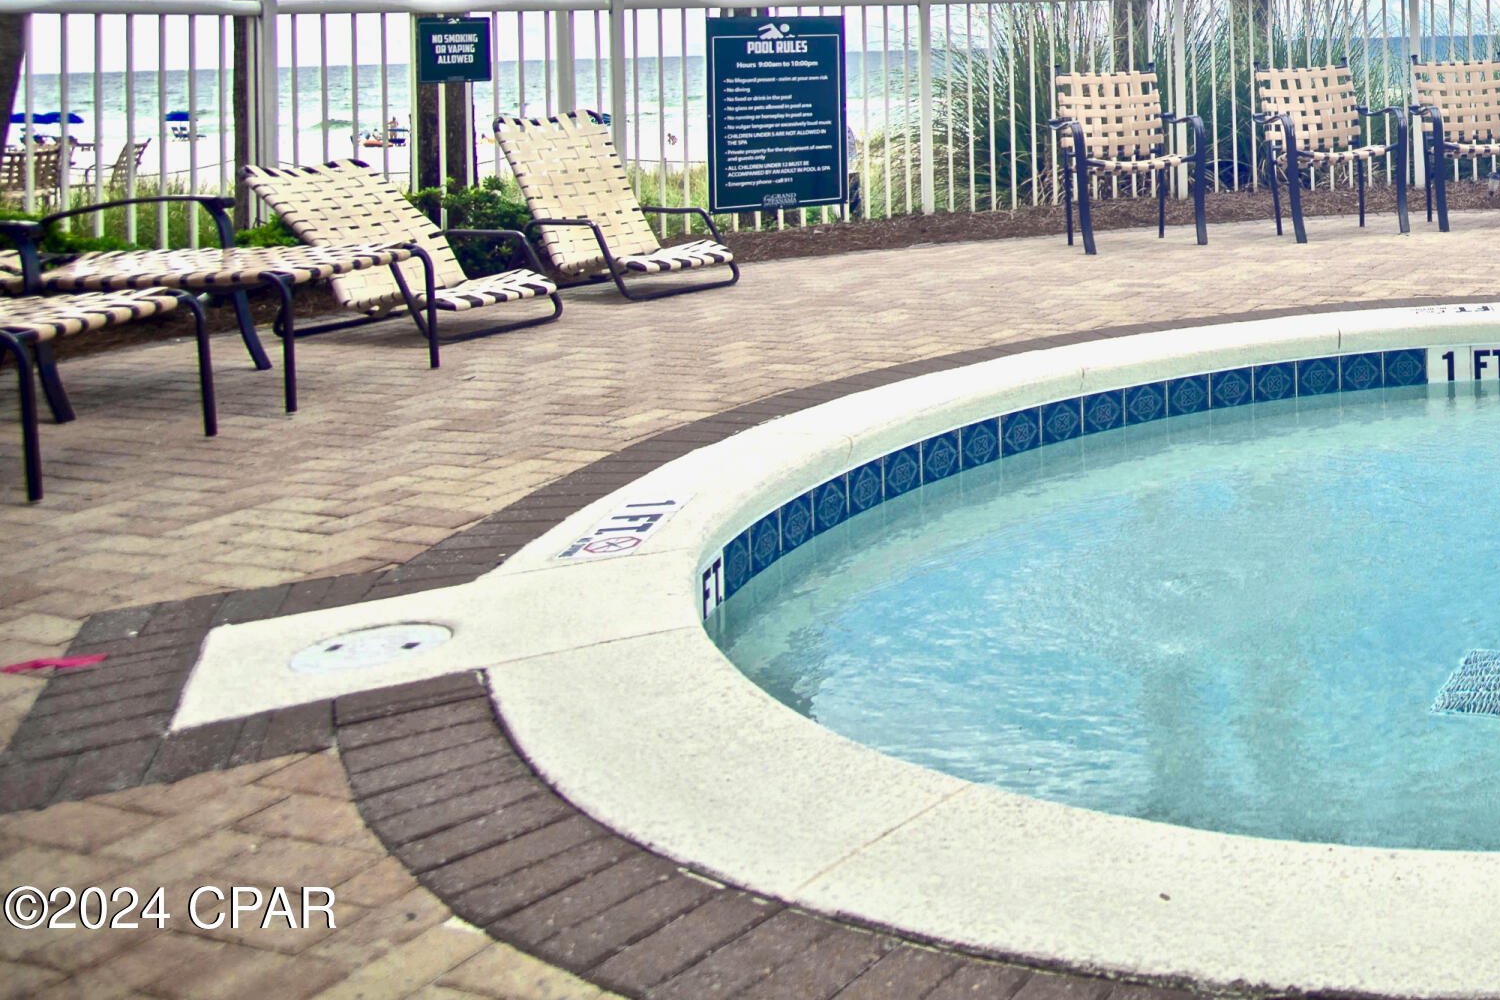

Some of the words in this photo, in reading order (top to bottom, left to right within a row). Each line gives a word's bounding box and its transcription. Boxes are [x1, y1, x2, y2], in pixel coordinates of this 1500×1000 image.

[431, 34, 443, 44] NO
[444, 33, 479, 43] SMOKING
[435, 44, 447, 54] OR
[447, 43, 476, 53] VAPING
[746, 40, 775, 54] POOL
[775, 40, 808, 53] RULES
[437, 54, 474, 64] ALLOWED
[736, 61, 757, 69] Hours
[727, 132, 753, 140] CHILDREN
[738, 163, 764, 171] CHILDREN
[727, 170, 765, 178] ACCOMPANIED
[1442, 351, 1455, 381] 1
